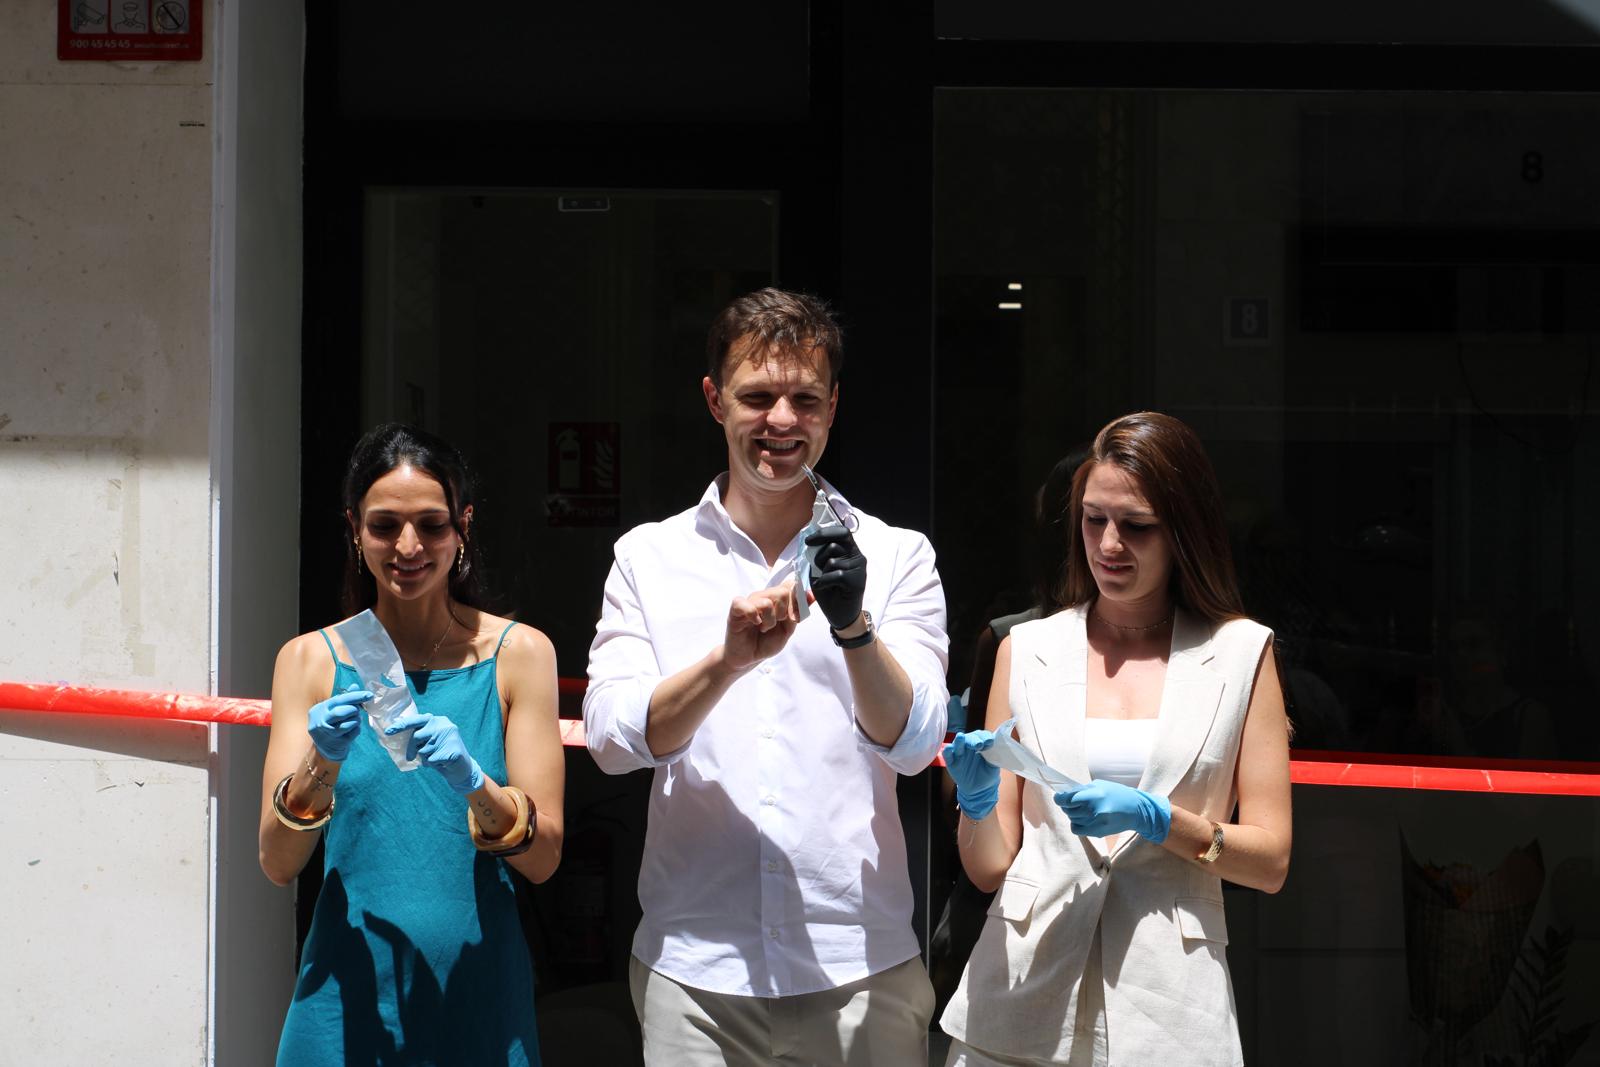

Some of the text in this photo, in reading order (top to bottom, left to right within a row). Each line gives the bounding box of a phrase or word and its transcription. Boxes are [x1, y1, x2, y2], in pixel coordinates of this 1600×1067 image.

[69, 39, 89, 48] 900
[91, 39, 103, 48] 45
[104, 39, 117, 48] 45
[118, 39, 130, 48] 45
